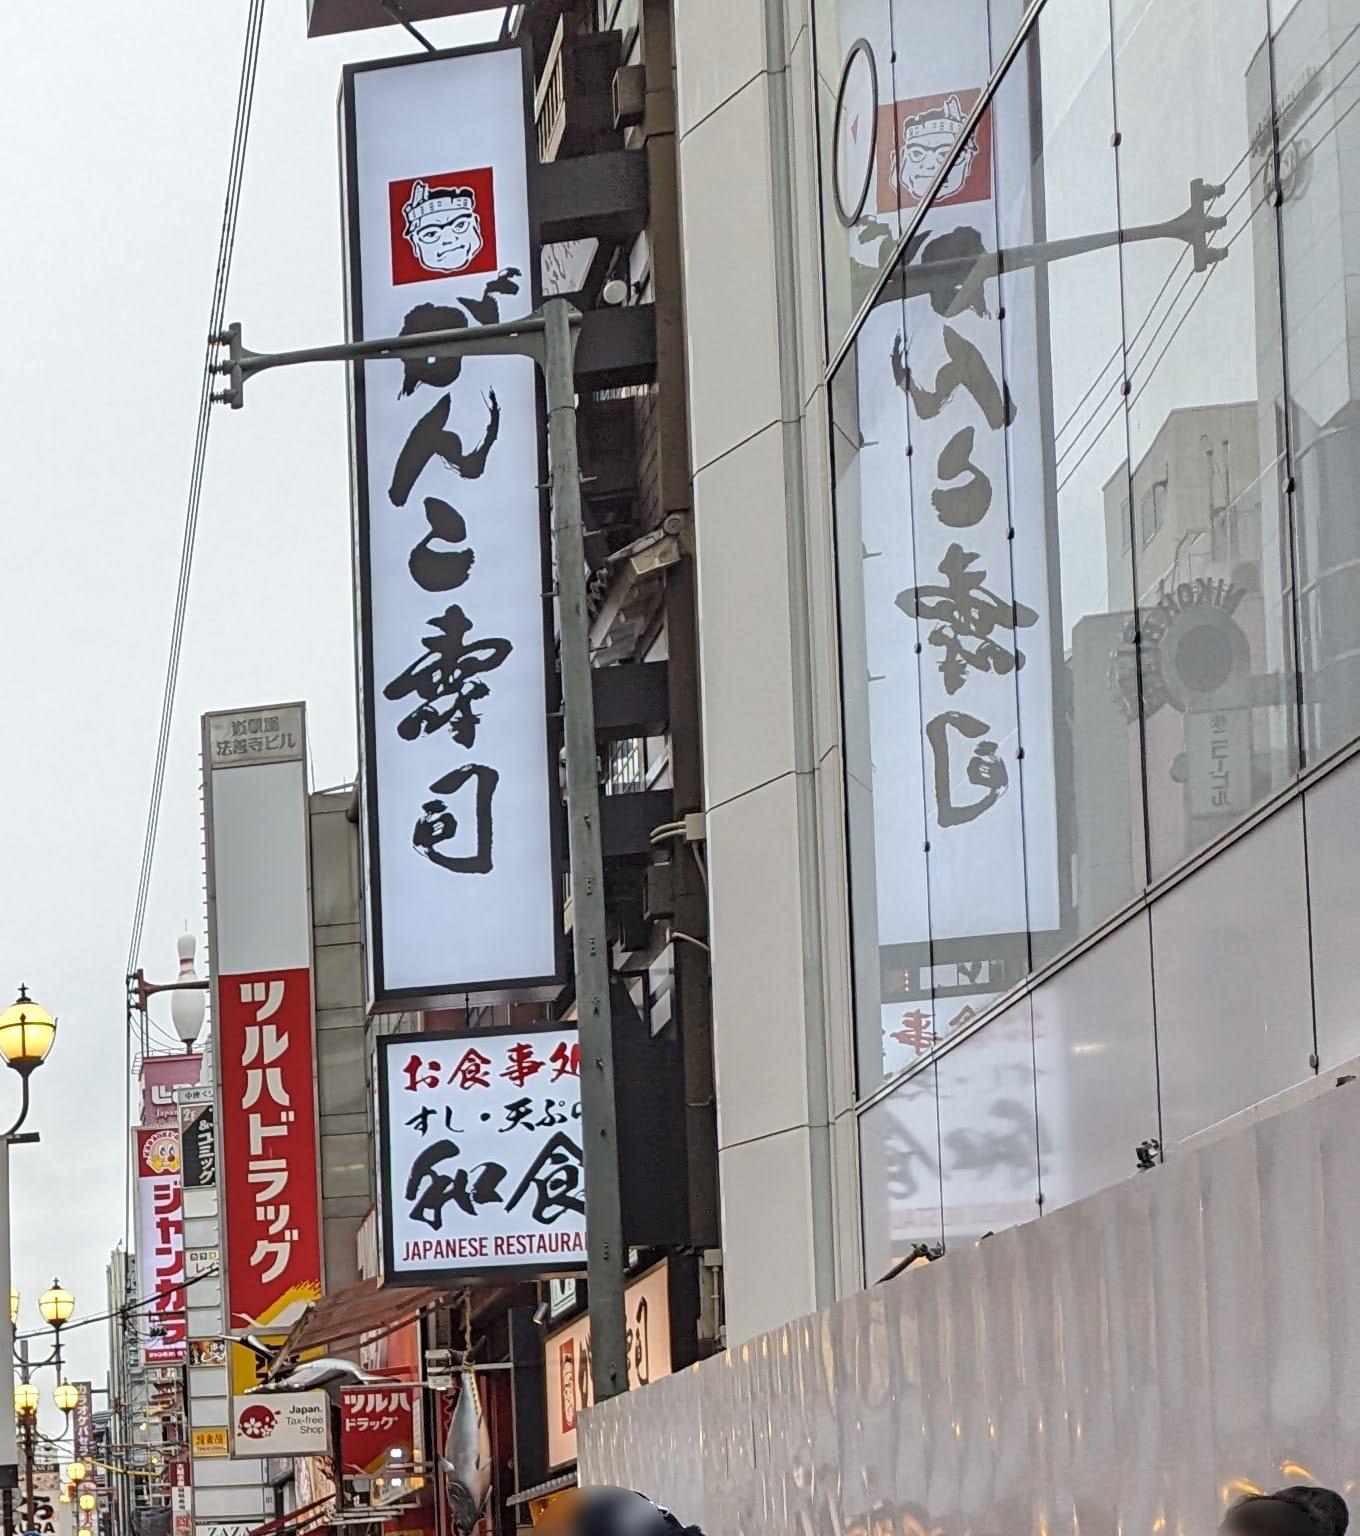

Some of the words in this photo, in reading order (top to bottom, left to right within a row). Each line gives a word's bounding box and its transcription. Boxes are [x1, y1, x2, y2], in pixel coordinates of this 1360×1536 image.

[403, 1041, 581, 1091] お食事処
[239, 981, 300, 1284] ツルハドラッグ
[405, 1131, 585, 1231] 和食
[403, 1236, 489, 1262] JAPANESE
[343, 1392, 411, 1413] ツルハ
[286, 1416, 324, 1425] Tax-free
[300, 1426, 324, 1435] Shop
[345, 1415, 399, 1432] ドラッグ
